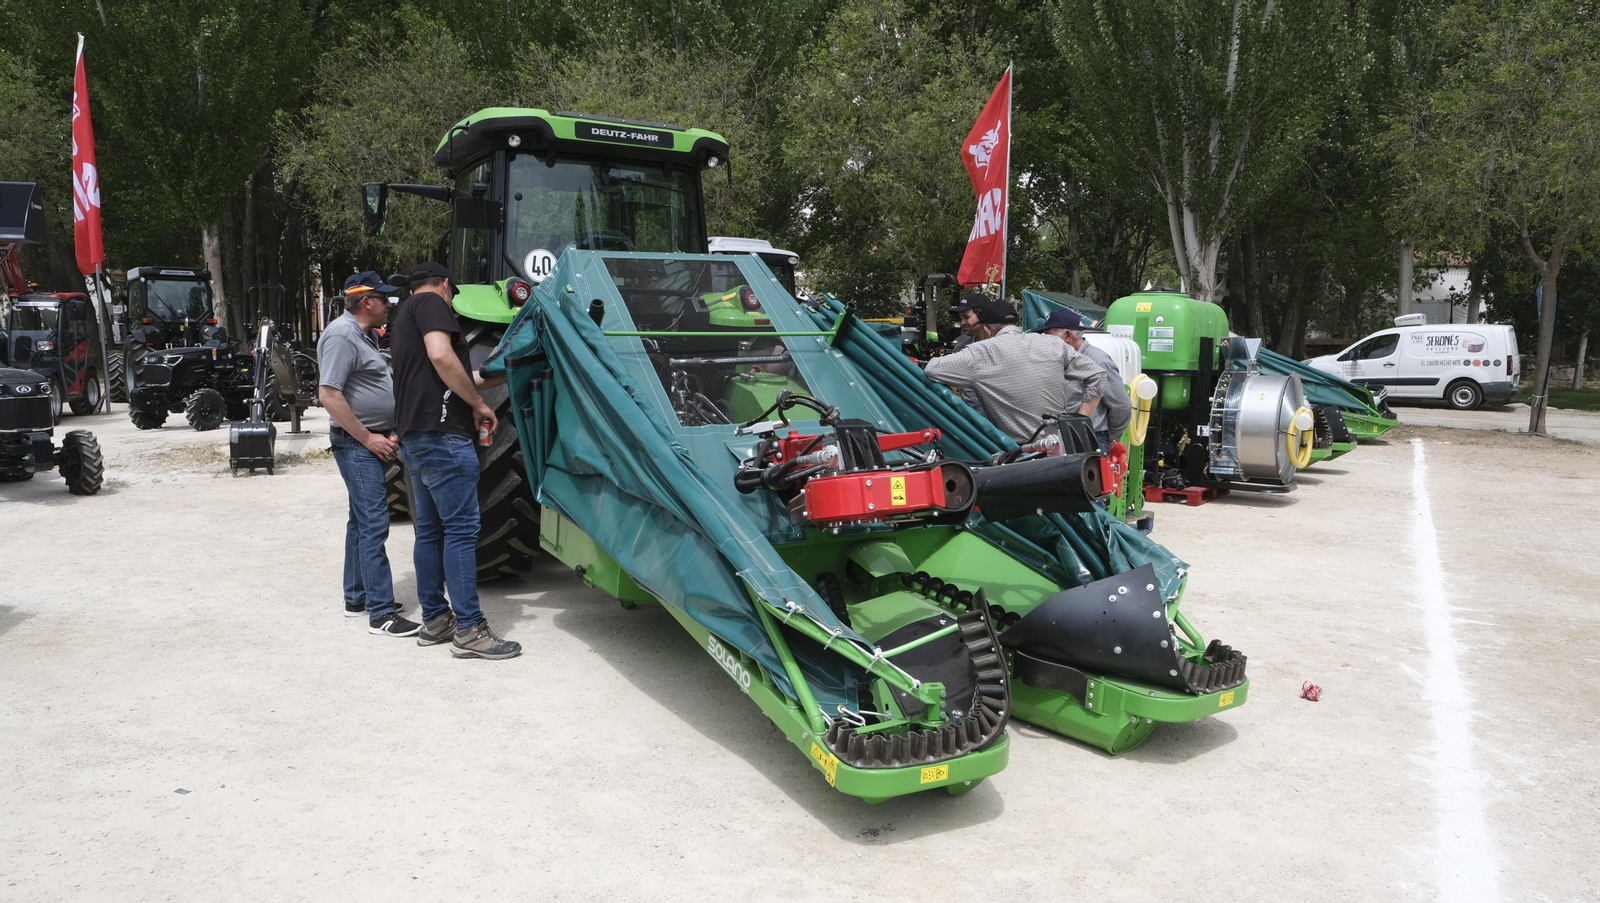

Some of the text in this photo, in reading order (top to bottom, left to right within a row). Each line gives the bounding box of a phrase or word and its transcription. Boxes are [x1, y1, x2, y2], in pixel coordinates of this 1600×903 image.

[591, 127, 659, 142] DEUTZ-FAHR
[531, 255, 552, 276] 40
[1425, 334, 1459, 347] SERONÉS
[707, 635, 751, 688] SOLANO
